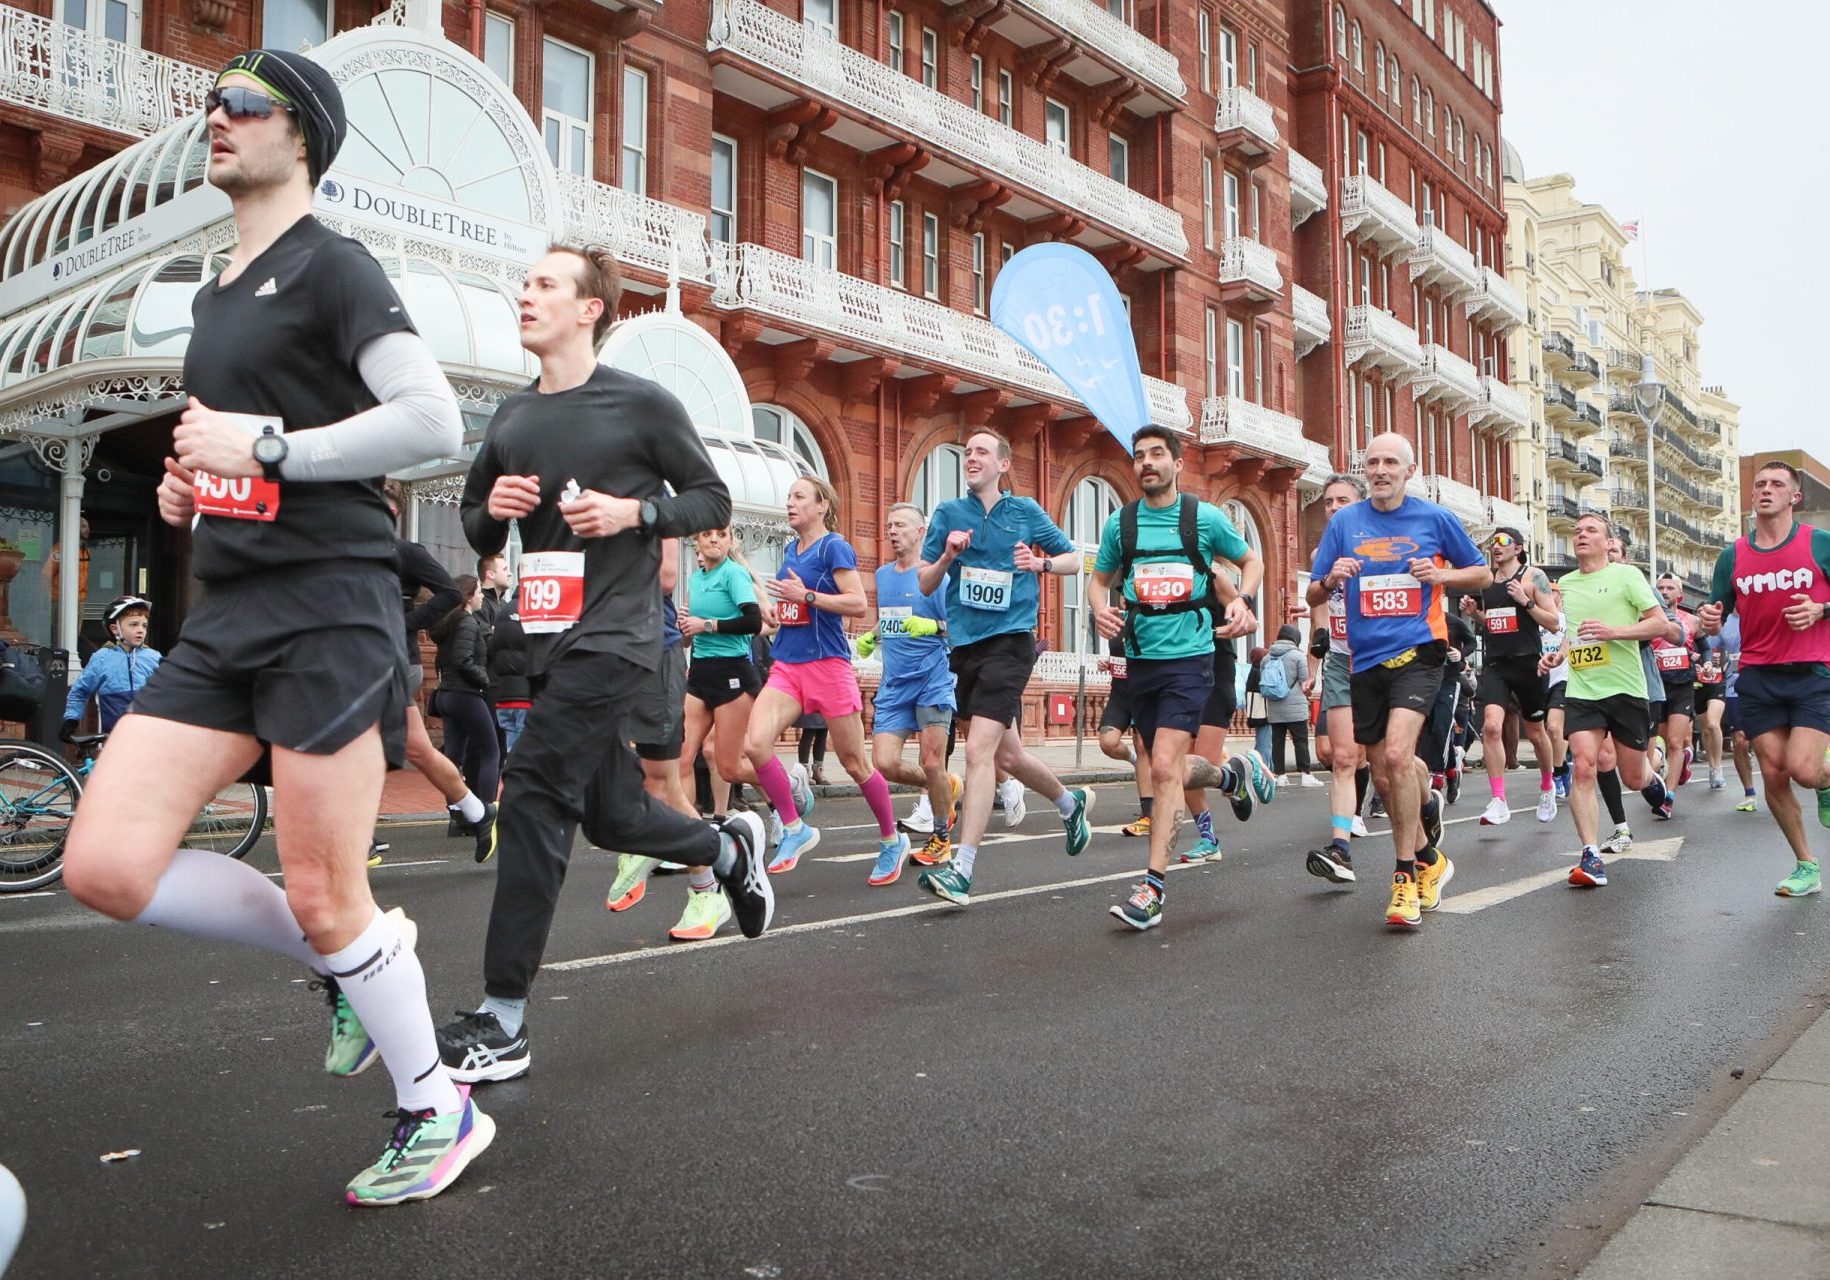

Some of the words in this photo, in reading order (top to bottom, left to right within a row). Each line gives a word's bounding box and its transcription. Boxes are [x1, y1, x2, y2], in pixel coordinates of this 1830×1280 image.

[504, 241, 527, 254] Hilton
[1141, 581, 1185, 597] 1:30
[1736, 567, 1813, 595] YMCA
[523, 579, 561, 611] 799
[966, 583, 1004, 605] 1909
[1372, 590, 1408, 611] 583
[781, 602, 799, 620] 346
[1490, 617, 1508, 630] 591
[1570, 646, 1603, 665] 3732
[1662, 657, 1682, 667] 624
